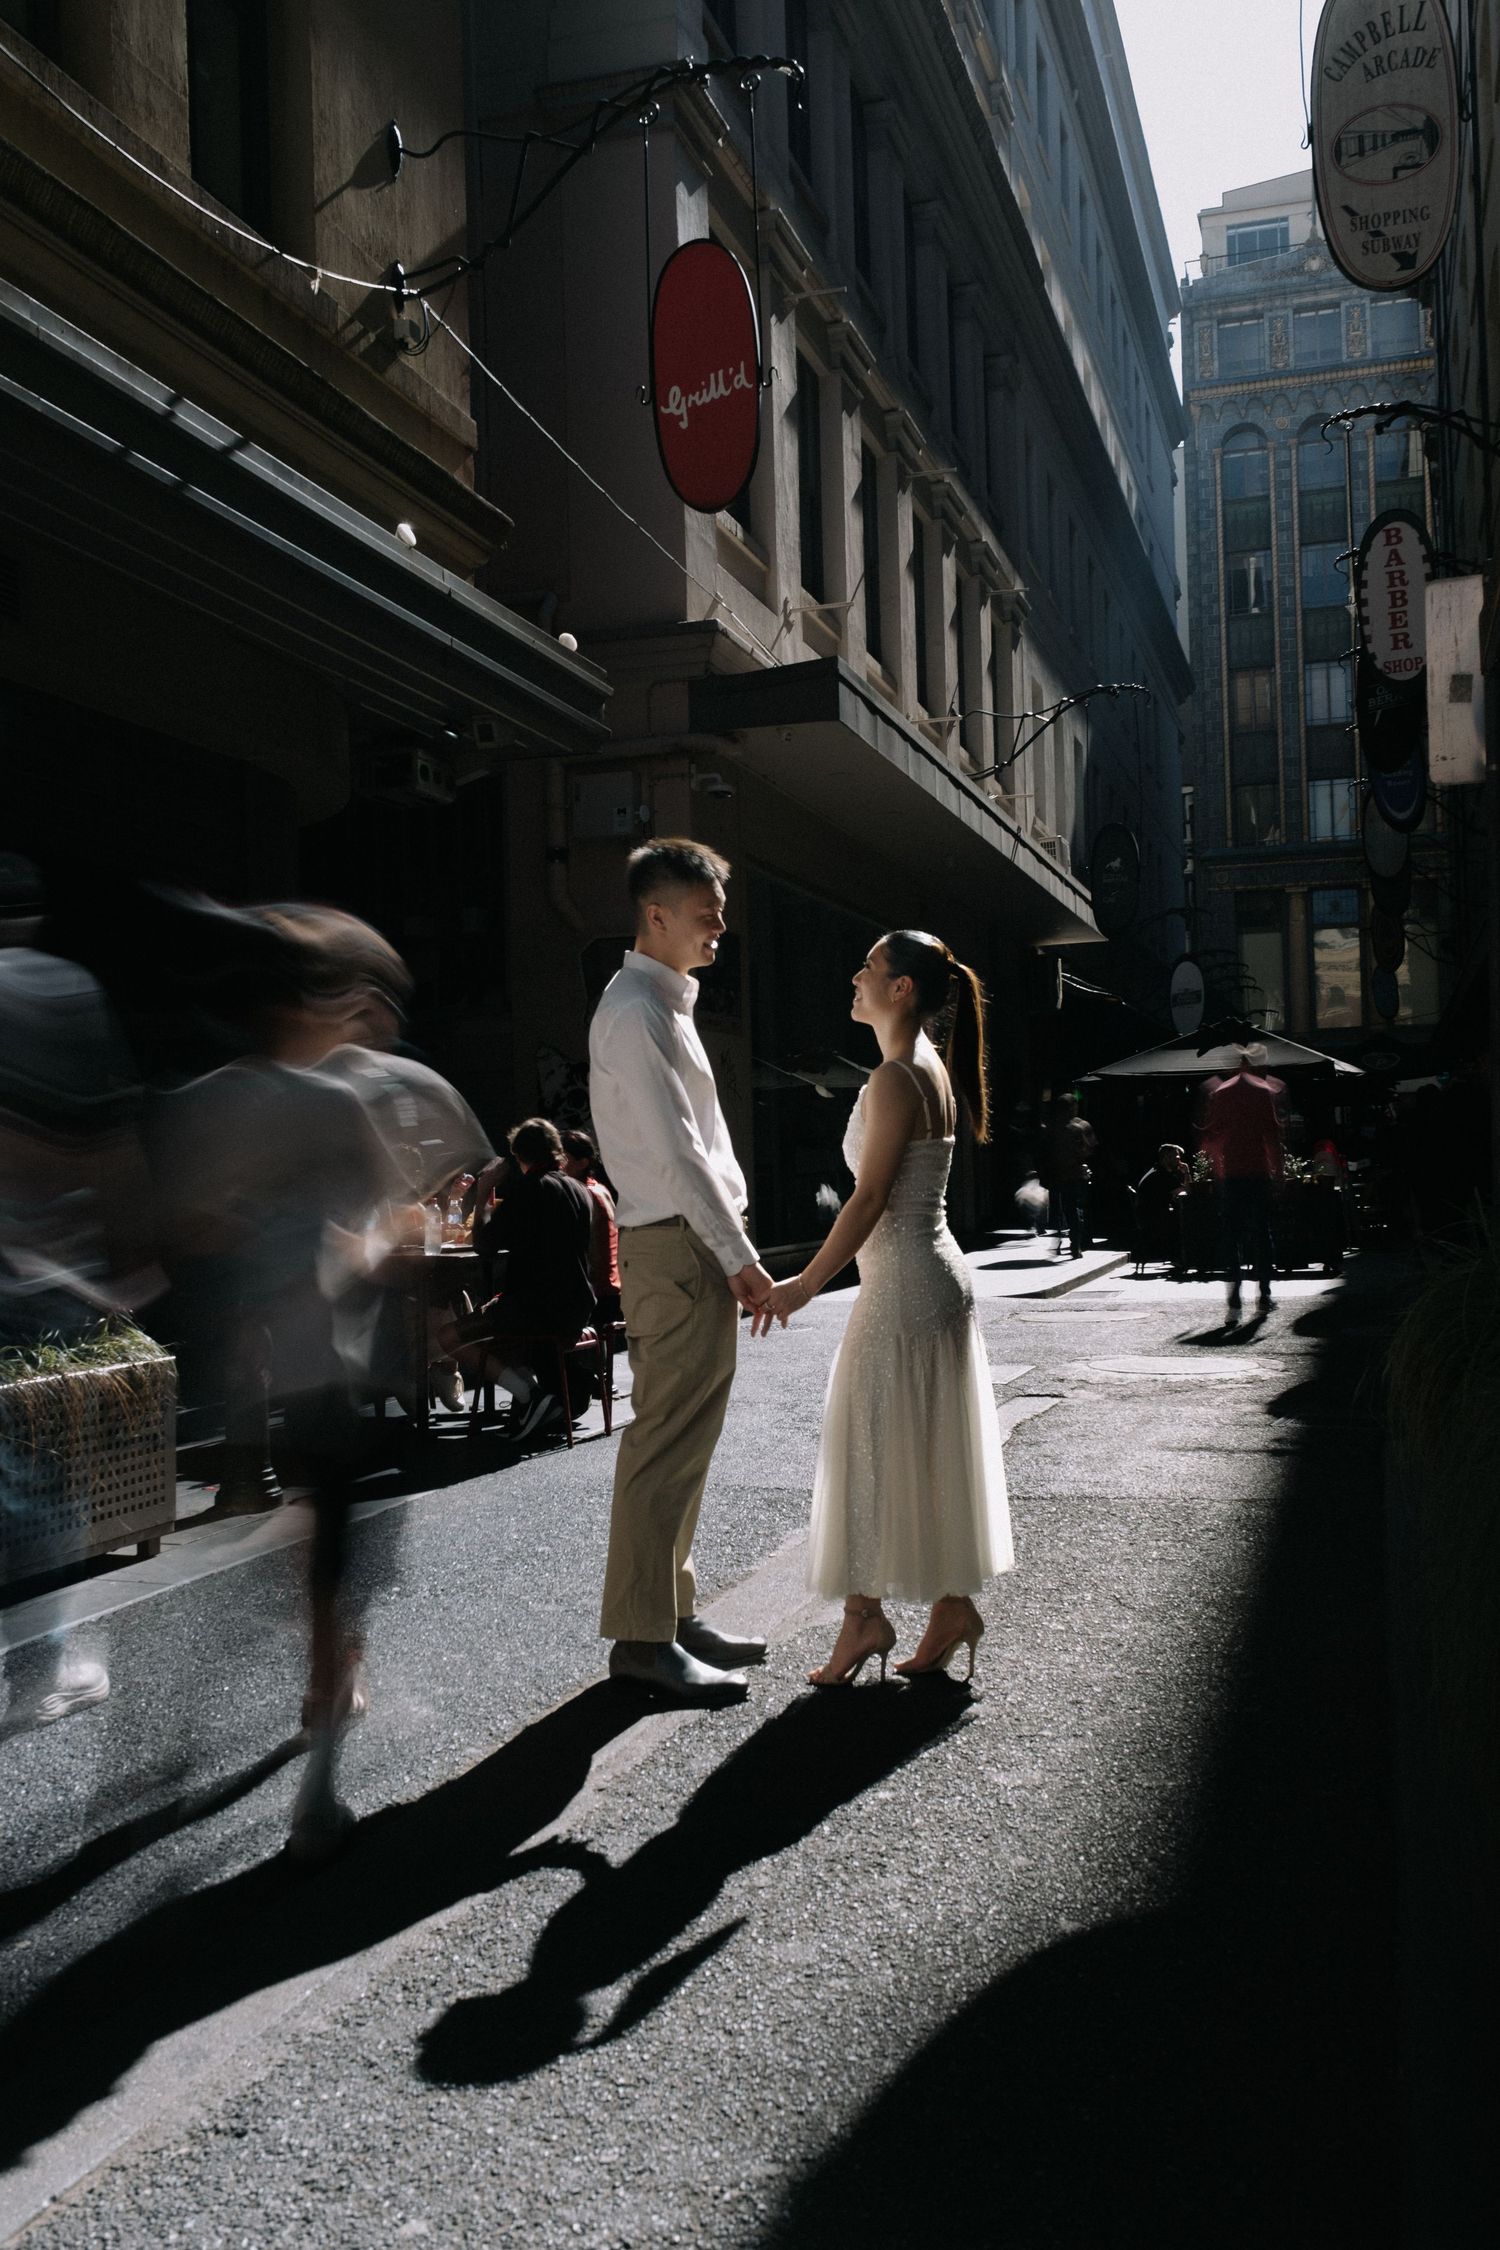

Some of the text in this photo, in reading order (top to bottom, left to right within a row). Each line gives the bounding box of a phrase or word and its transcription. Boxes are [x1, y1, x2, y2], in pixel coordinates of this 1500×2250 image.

[1323, 0, 1428, 83] CAMPBELL
[1362, 46, 1442, 84] ARCADE
[1350, 205, 1431, 233] SHOPPING
[1361, 231, 1422, 257] SUBWAY
[660, 360, 753, 430] Grill'd
[1383, 527, 1413, 651] BARBER
[1383, 656, 1424, 674] SHOP
